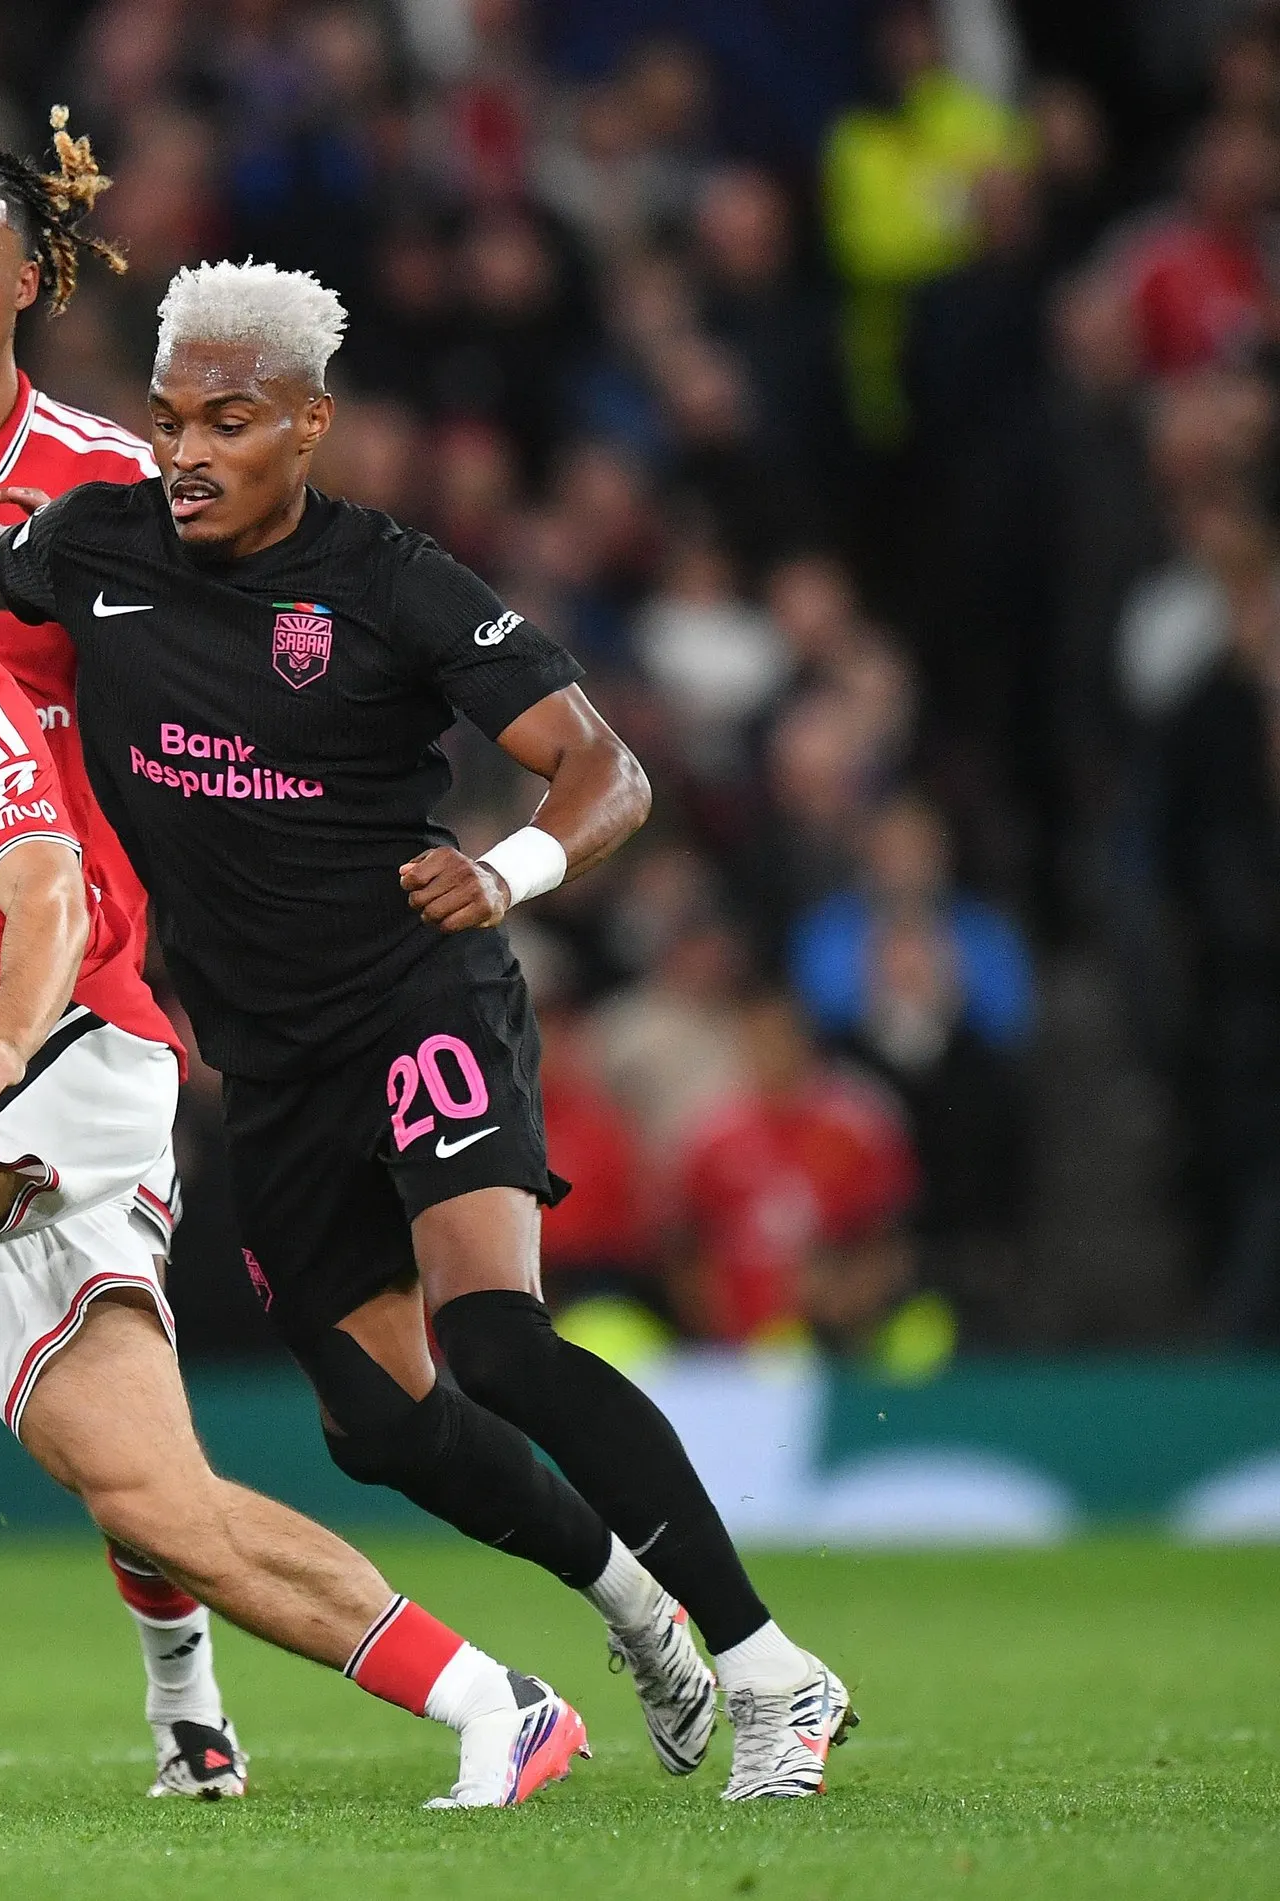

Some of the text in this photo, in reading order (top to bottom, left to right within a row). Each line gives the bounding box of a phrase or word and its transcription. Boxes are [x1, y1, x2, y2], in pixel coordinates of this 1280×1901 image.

[276, 631, 329, 656] SABAH
[160, 723, 256, 763] Bank
[130, 745, 324, 800] Respublika
[386, 1034, 489, 1153] 20
